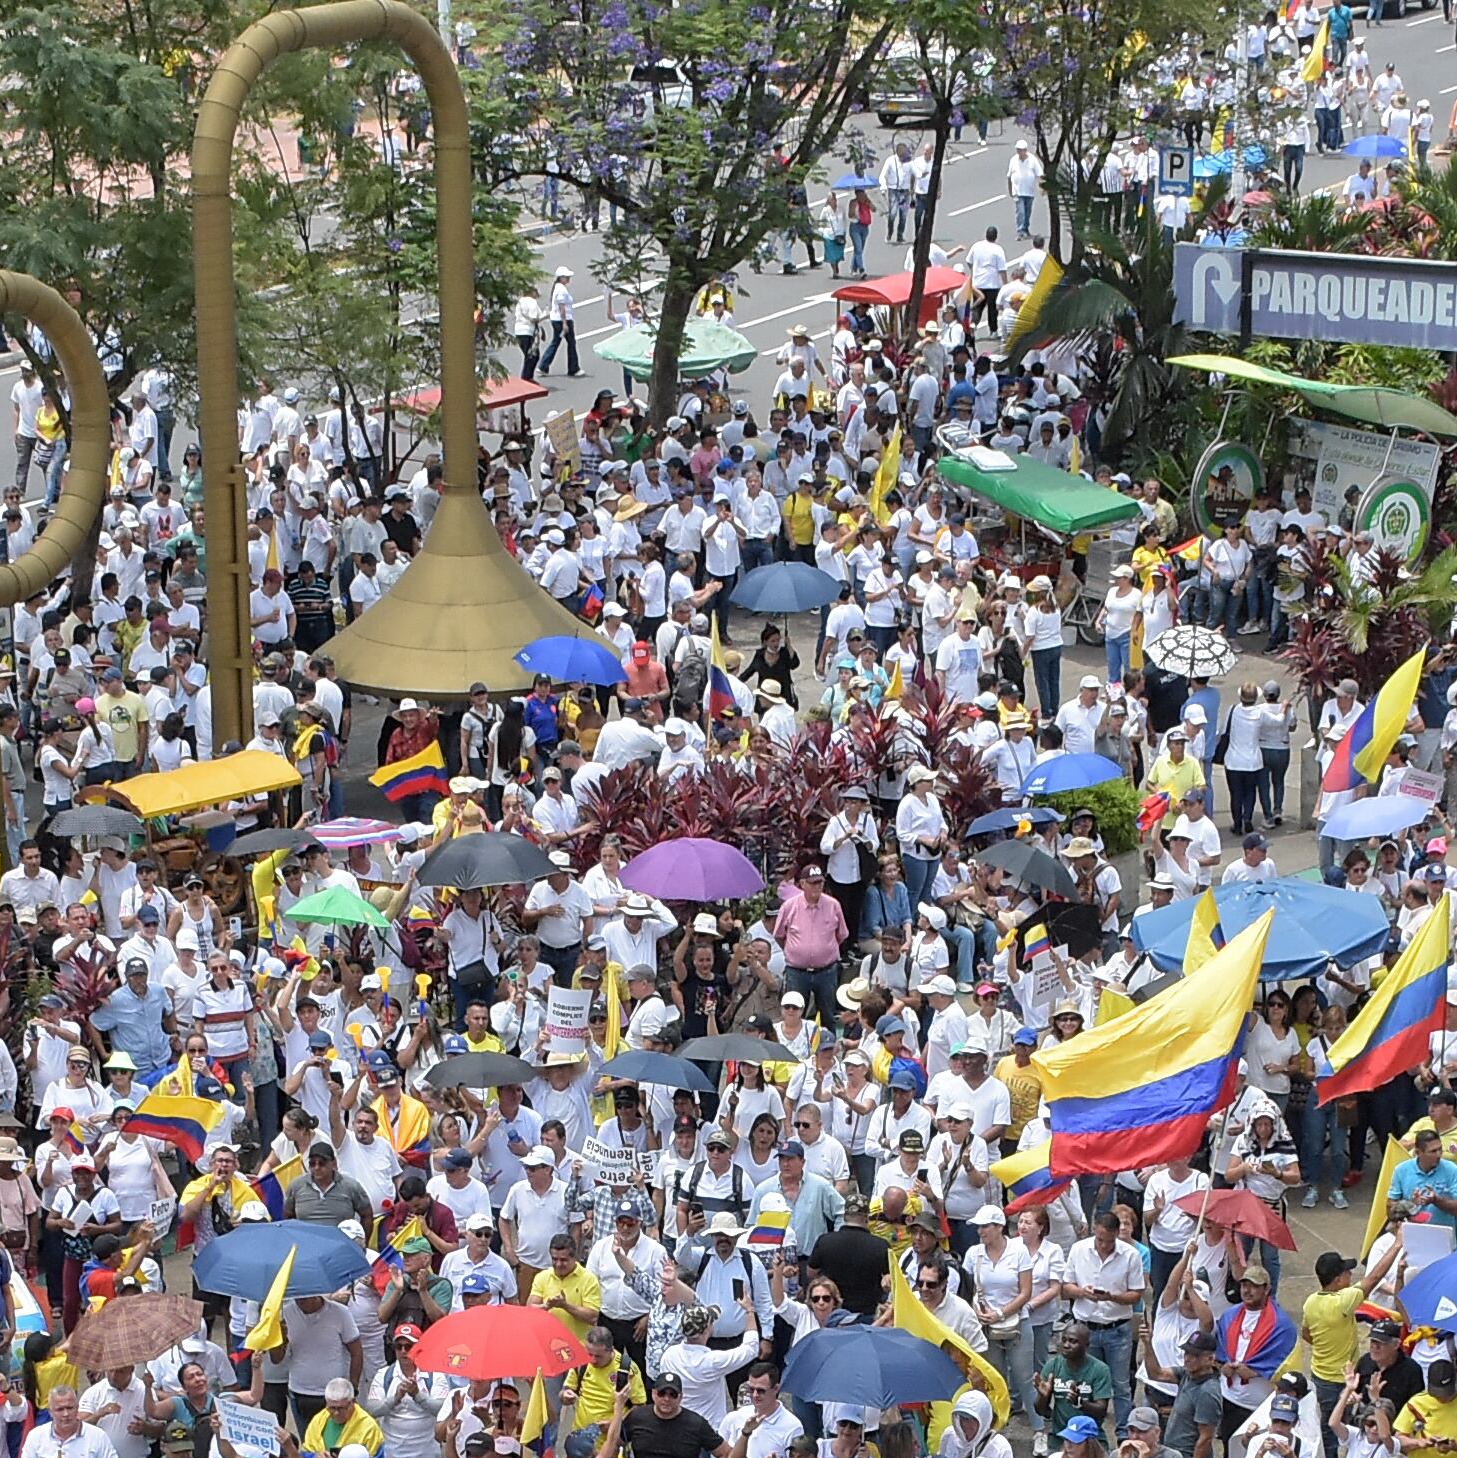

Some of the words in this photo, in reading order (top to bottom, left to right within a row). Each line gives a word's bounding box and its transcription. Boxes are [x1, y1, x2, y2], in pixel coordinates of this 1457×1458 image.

[1170, 152, 1184, 179] P
[553, 1002, 584, 1012] GOBIERNO
[586, 1139, 633, 1161] Renuncia
[640, 1154, 654, 1183] Petr
[151, 1202, 170, 1218] Petro
[227, 1418, 253, 1431] estoy
[254, 1426, 274, 1435] con
[228, 1426, 275, 1450] Israel
